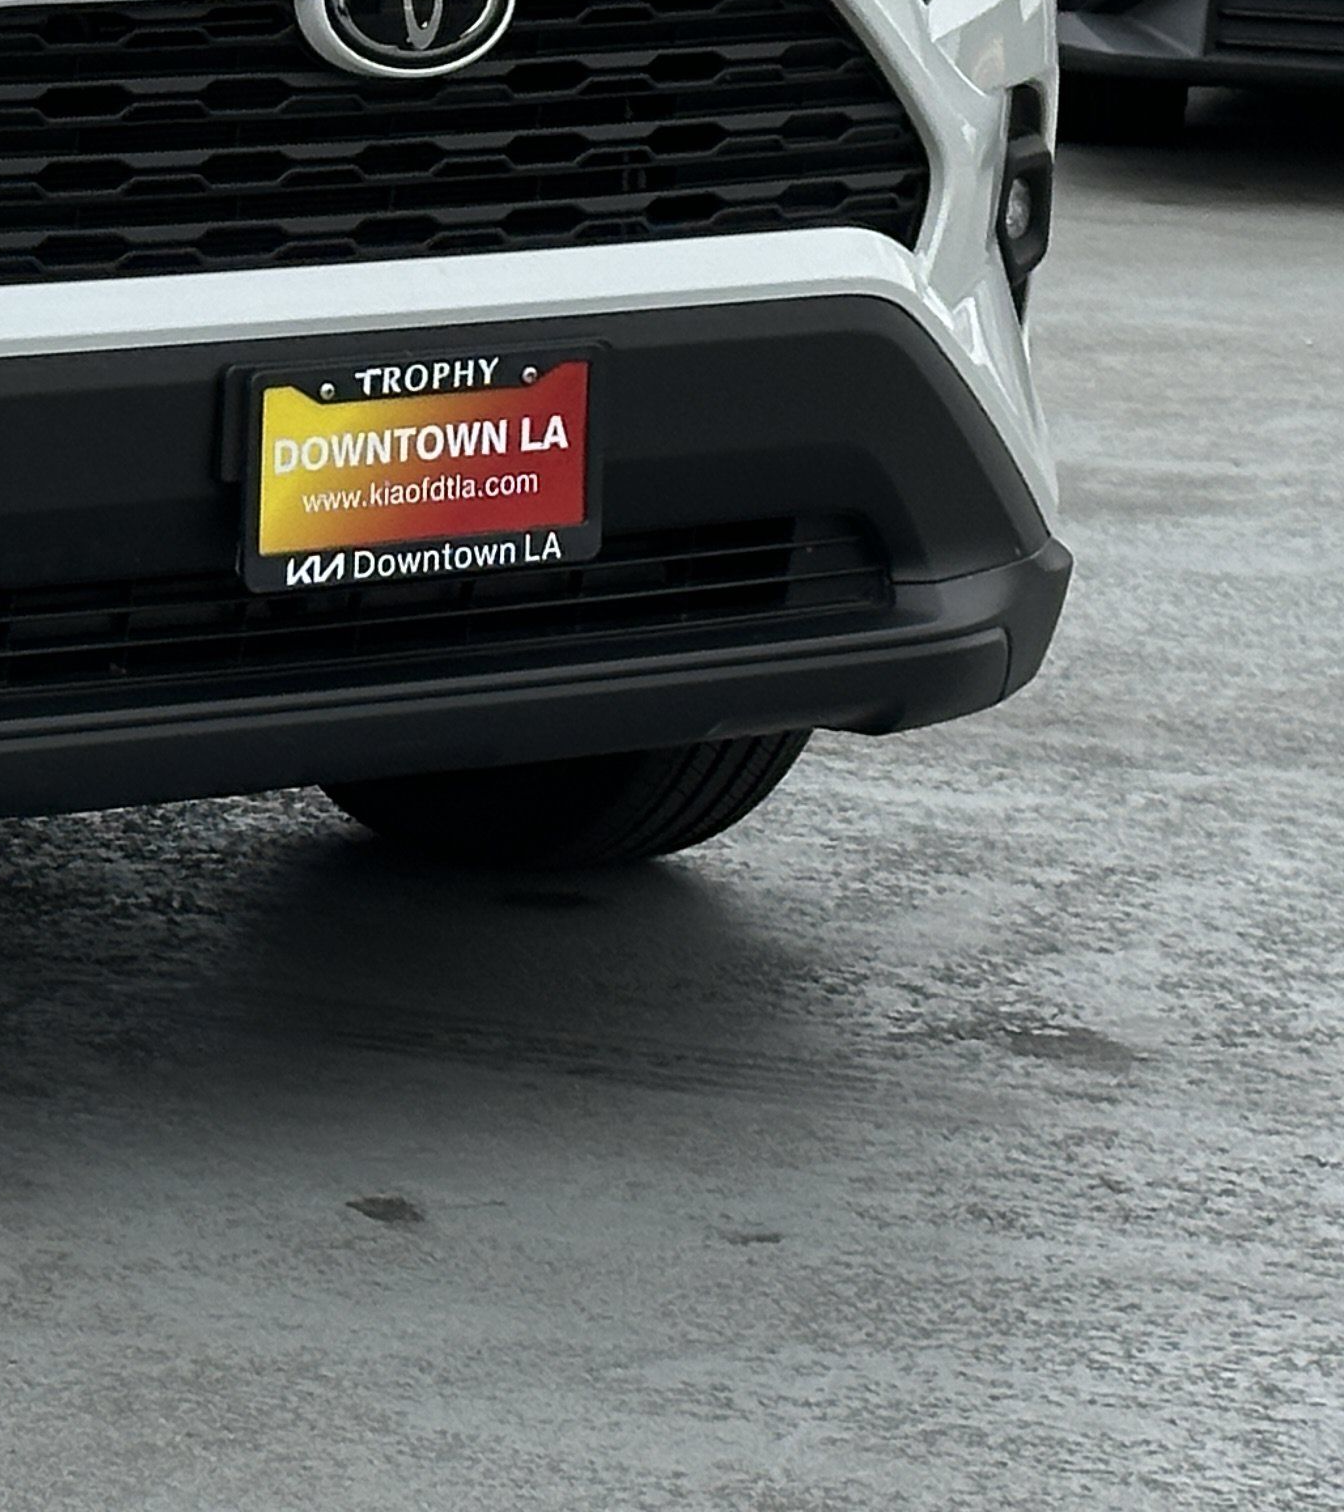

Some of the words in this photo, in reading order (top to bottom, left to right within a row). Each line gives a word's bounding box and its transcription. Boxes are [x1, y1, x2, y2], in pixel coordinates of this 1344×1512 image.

[355, 357, 500, 397] TROPHY
[274, 420, 508, 475] DOWNTOWN
[520, 415, 569, 454] LA
[302, 472, 538, 514] www.kiaofdtla.com
[353, 541, 516, 580] Downtown
[524, 531, 562, 563] LA
